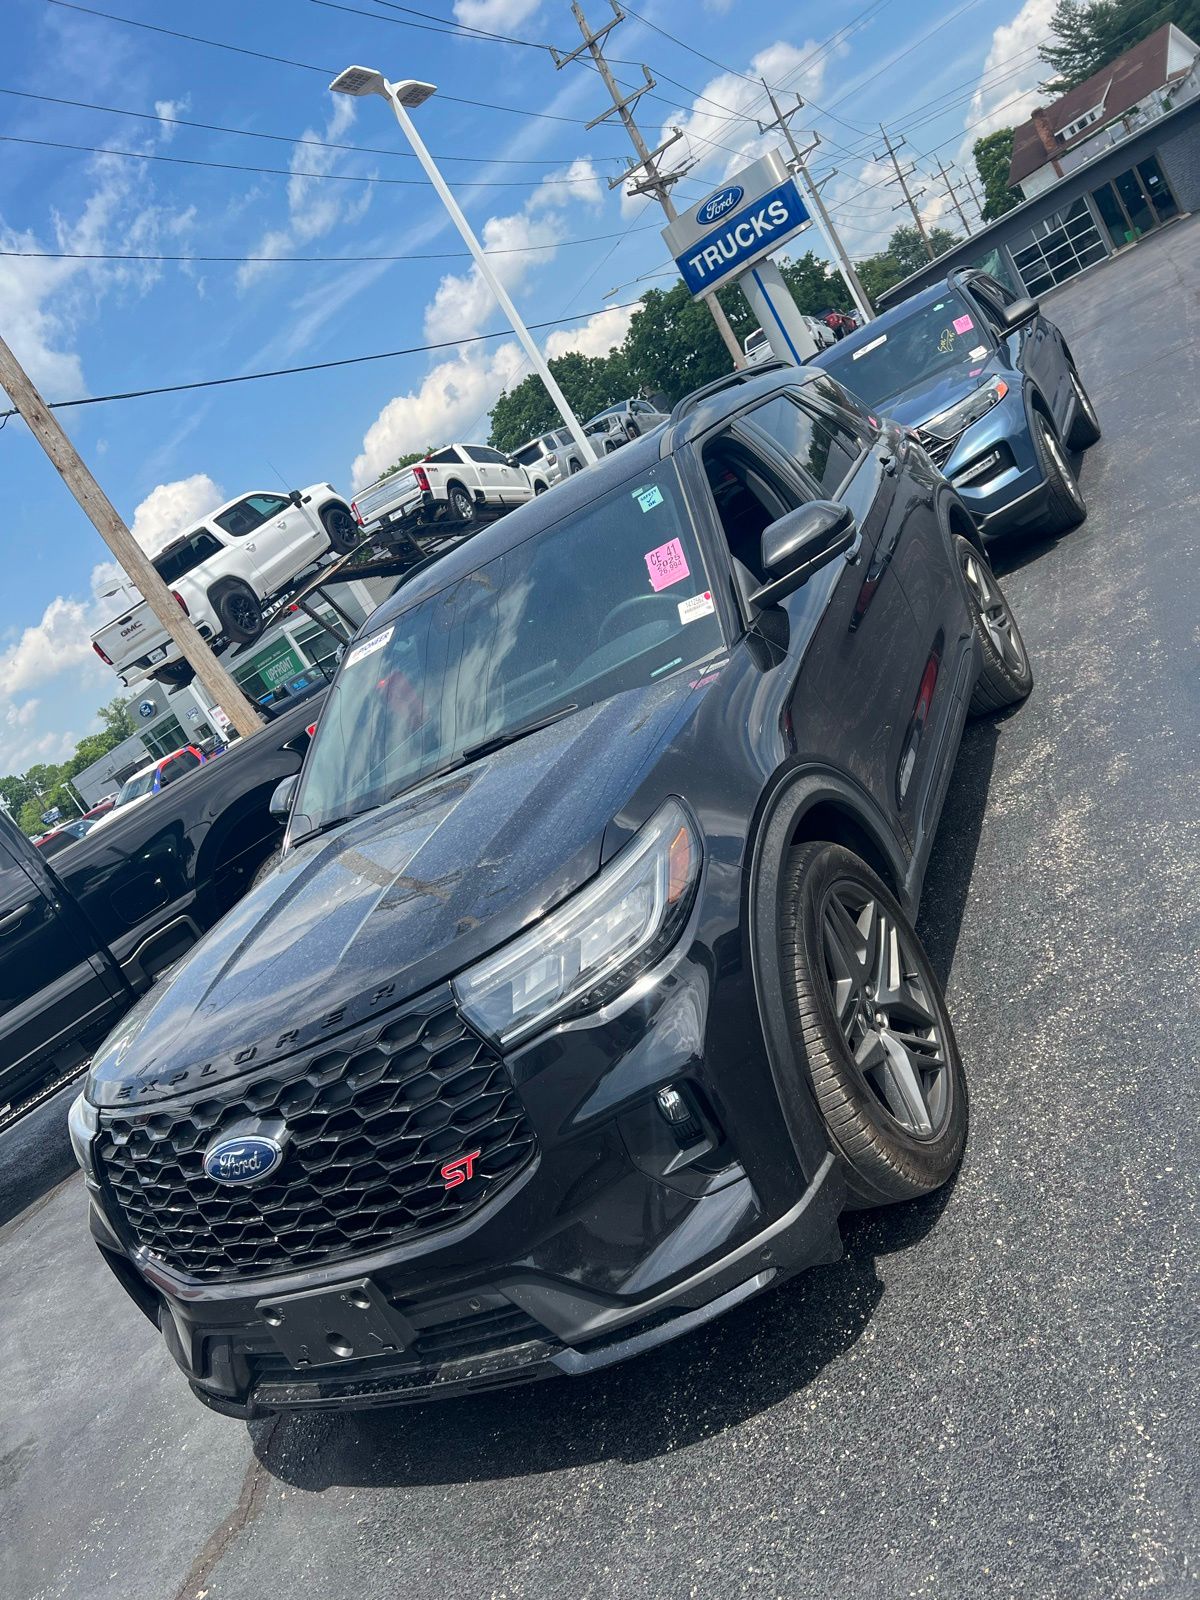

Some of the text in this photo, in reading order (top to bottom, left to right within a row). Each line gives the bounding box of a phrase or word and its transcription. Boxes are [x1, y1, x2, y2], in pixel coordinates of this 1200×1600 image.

[706, 192, 735, 220] Ford
[688, 200, 789, 278] TRUCKS
[640, 488, 657, 501] SAFETY
[647, 499, 657, 507] OK
[650, 543, 677, 567] CE 41
[656, 554, 681, 571] 2025
[658, 560, 682, 577] 26,994
[120, 620, 143, 637] GMC
[265, 656, 294, 682] UPFRONT
[117, 983, 396, 1099] EXPLORER
[219, 1148, 263, 1179] Ford
[441, 1150, 481, 1190] ST
